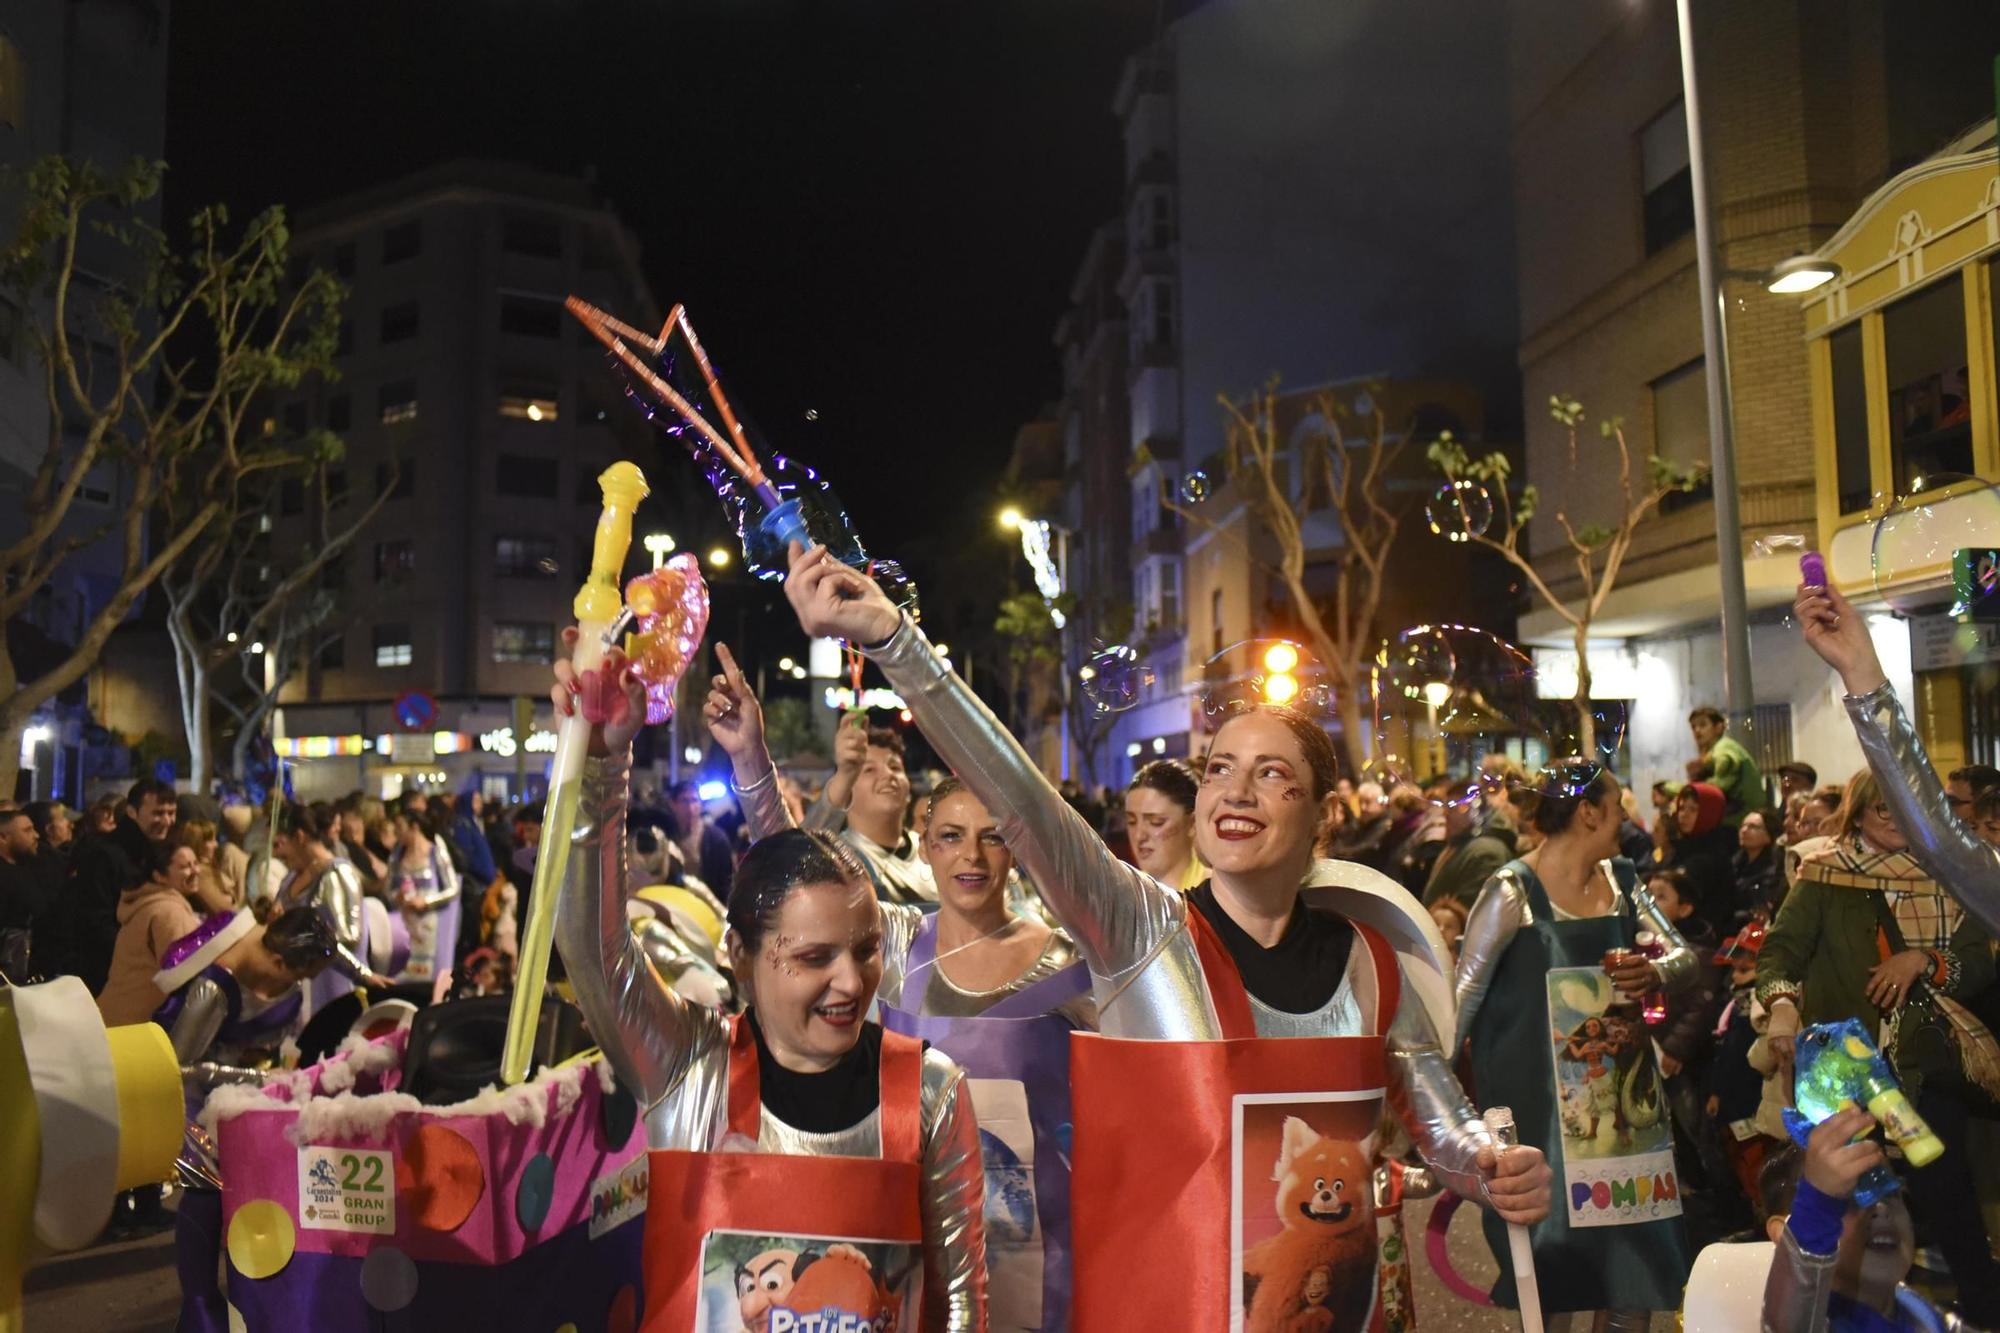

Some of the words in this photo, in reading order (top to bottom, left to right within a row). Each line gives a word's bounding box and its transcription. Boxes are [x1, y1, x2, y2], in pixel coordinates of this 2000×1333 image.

[341, 1154, 385, 1193] 22
[314, 1195, 335, 1204] 2024
[343, 1196, 385, 1210] GRAN
[343, 1212, 386, 1226] GRUP
